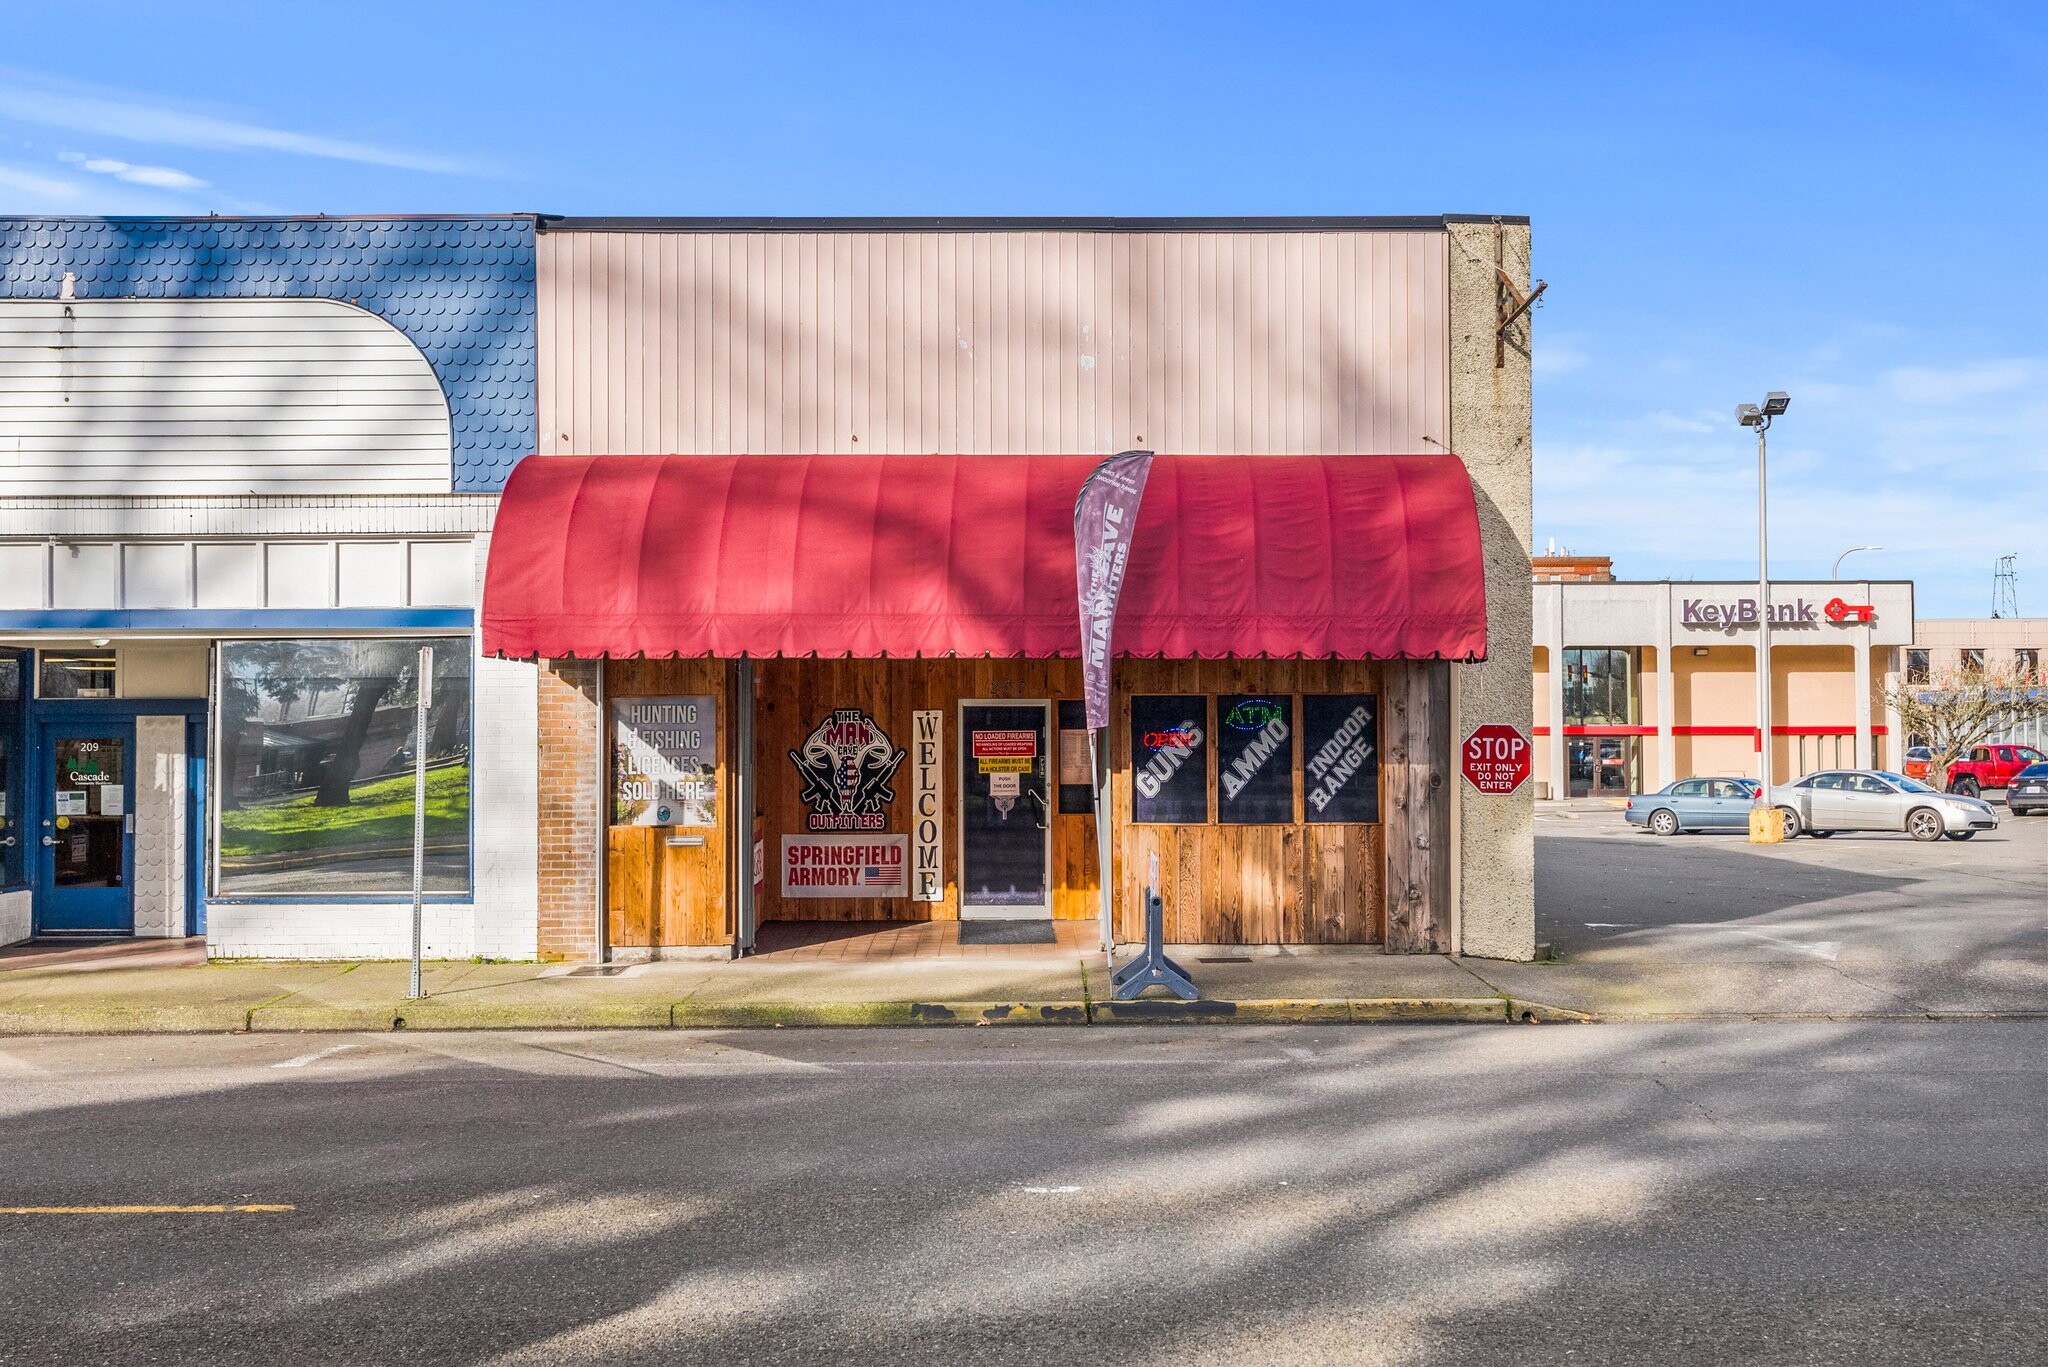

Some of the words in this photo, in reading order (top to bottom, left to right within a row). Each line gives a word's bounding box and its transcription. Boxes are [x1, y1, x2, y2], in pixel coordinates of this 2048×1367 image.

[631, 705, 697, 724] HUNTING
[835, 710, 861, 721] THE
[1225, 706, 1281, 724] ATM
[627, 731, 638, 750] &
[642, 730, 701, 750] FISHING
[826, 721, 870, 745] MAN
[975, 732, 984, 740] NO
[984, 732, 1006, 740] LOADED
[1007, 732, 1034, 740] FIREARMS
[1144, 732, 1192, 747] OPEN
[80, 742, 99, 752] 209
[837, 745, 858, 756] CAVE
[1306, 705, 1373, 781] INDOOR
[1469, 737, 1524, 760] STOP
[628, 756, 700, 775] LICENSES
[1136, 720, 1203, 799] GUNS
[1221, 717, 1289, 801] AMMO
[1470, 763, 1491, 771] EXIT
[1495, 763, 1523, 772] ONLY
[70, 771, 110, 781] Cascade
[1307, 735, 1374, 813] RANGE
[1478, 772, 1492, 780] DO
[1495, 772, 1515, 780] NOT
[622, 781, 661, 801] SOLD
[665, 781, 705, 801] HERE
[1480, 781, 1512, 789] ENTER
[917, 715, 939, 896] WELCOME
[809, 813, 884, 830] OUTFITTERS
[788, 845, 902, 866] SPRINGFIELD
